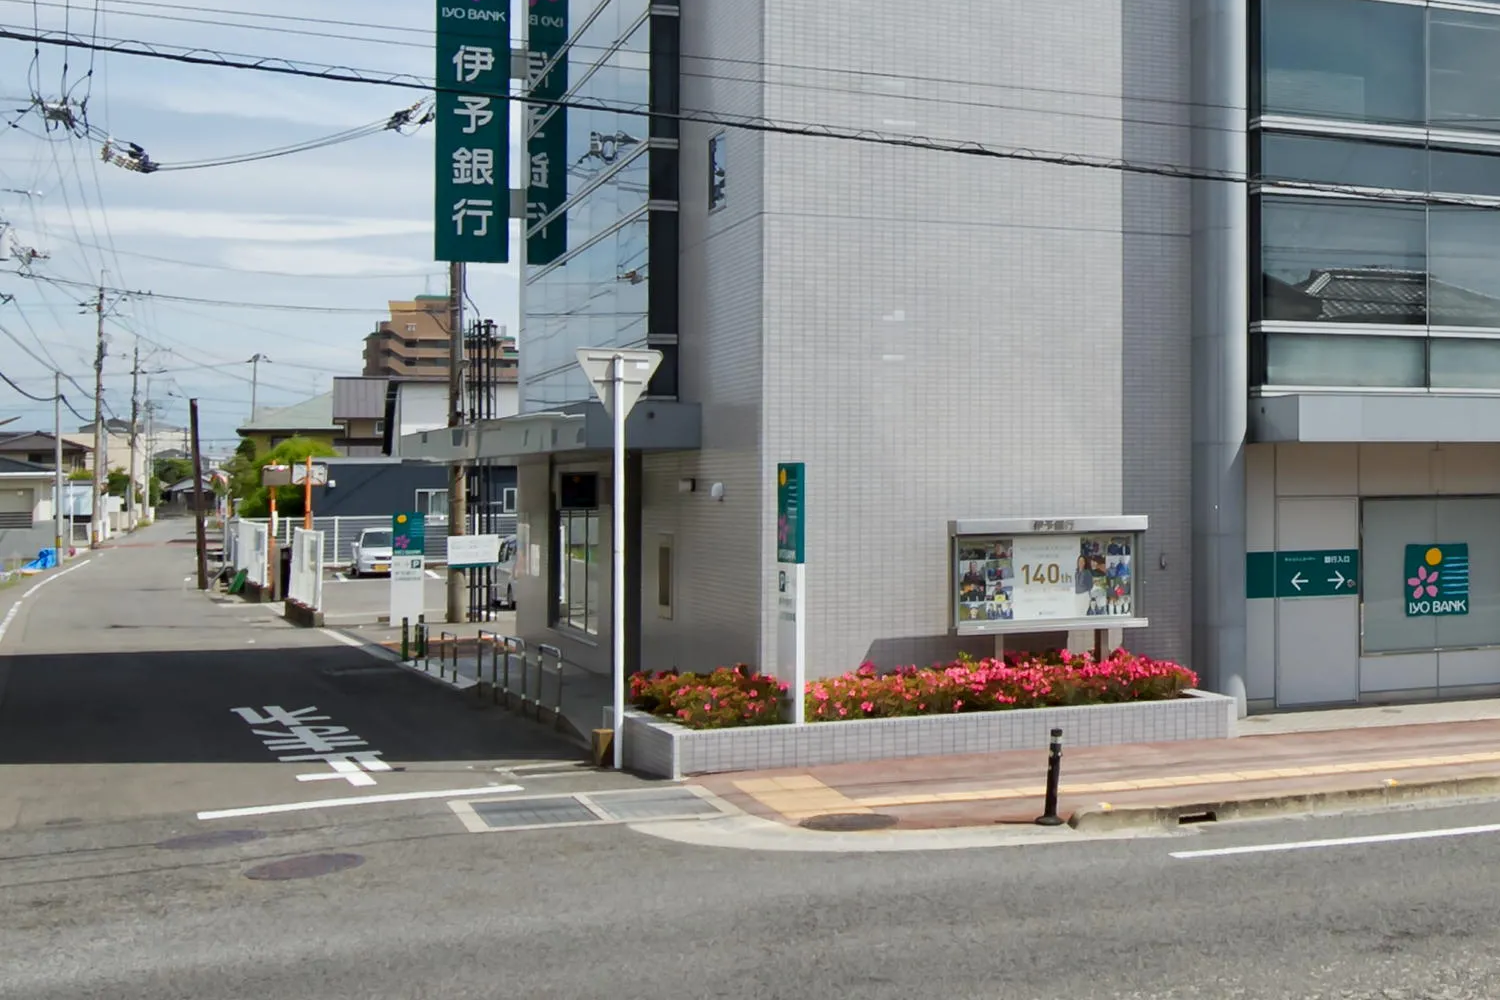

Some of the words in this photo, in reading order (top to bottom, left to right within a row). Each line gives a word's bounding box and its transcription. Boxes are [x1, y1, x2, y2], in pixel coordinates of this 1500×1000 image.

[441, 6, 466, 19] IYO
[467, 8, 506, 22] BANK
[451, 44, 495, 237] 伊予銀行
[1020, 563, 1073, 585] 140th
[1409, 601, 1430, 614] IYO
[1432, 600, 1466, 613] BANK
[229, 705, 393, 787] 止まれ
